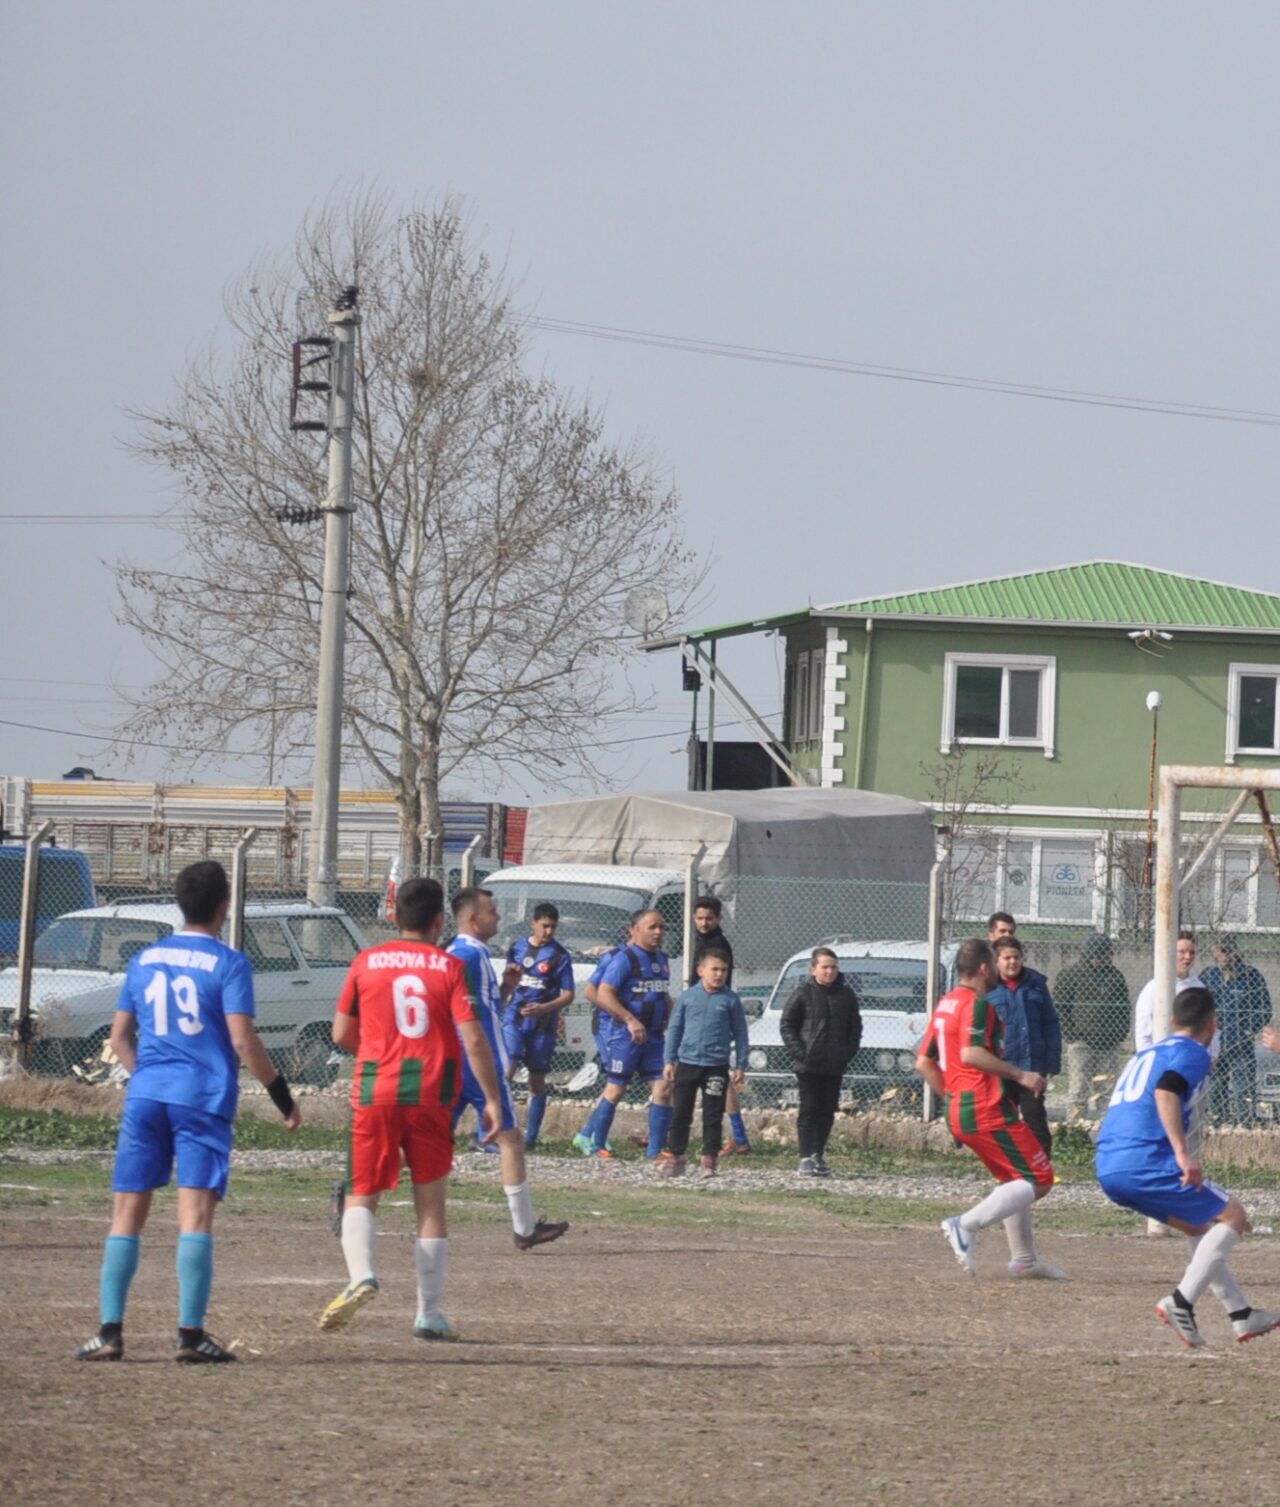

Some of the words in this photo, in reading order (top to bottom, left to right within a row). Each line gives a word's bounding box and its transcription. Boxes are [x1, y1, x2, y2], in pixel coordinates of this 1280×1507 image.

[367, 951, 426, 970] KOSOVA
[144, 970, 204, 1036] 19
[392, 974, 429, 1039] 6
[611, 1059, 624, 1074] 10
[1109, 1050, 1156, 1107] 20
